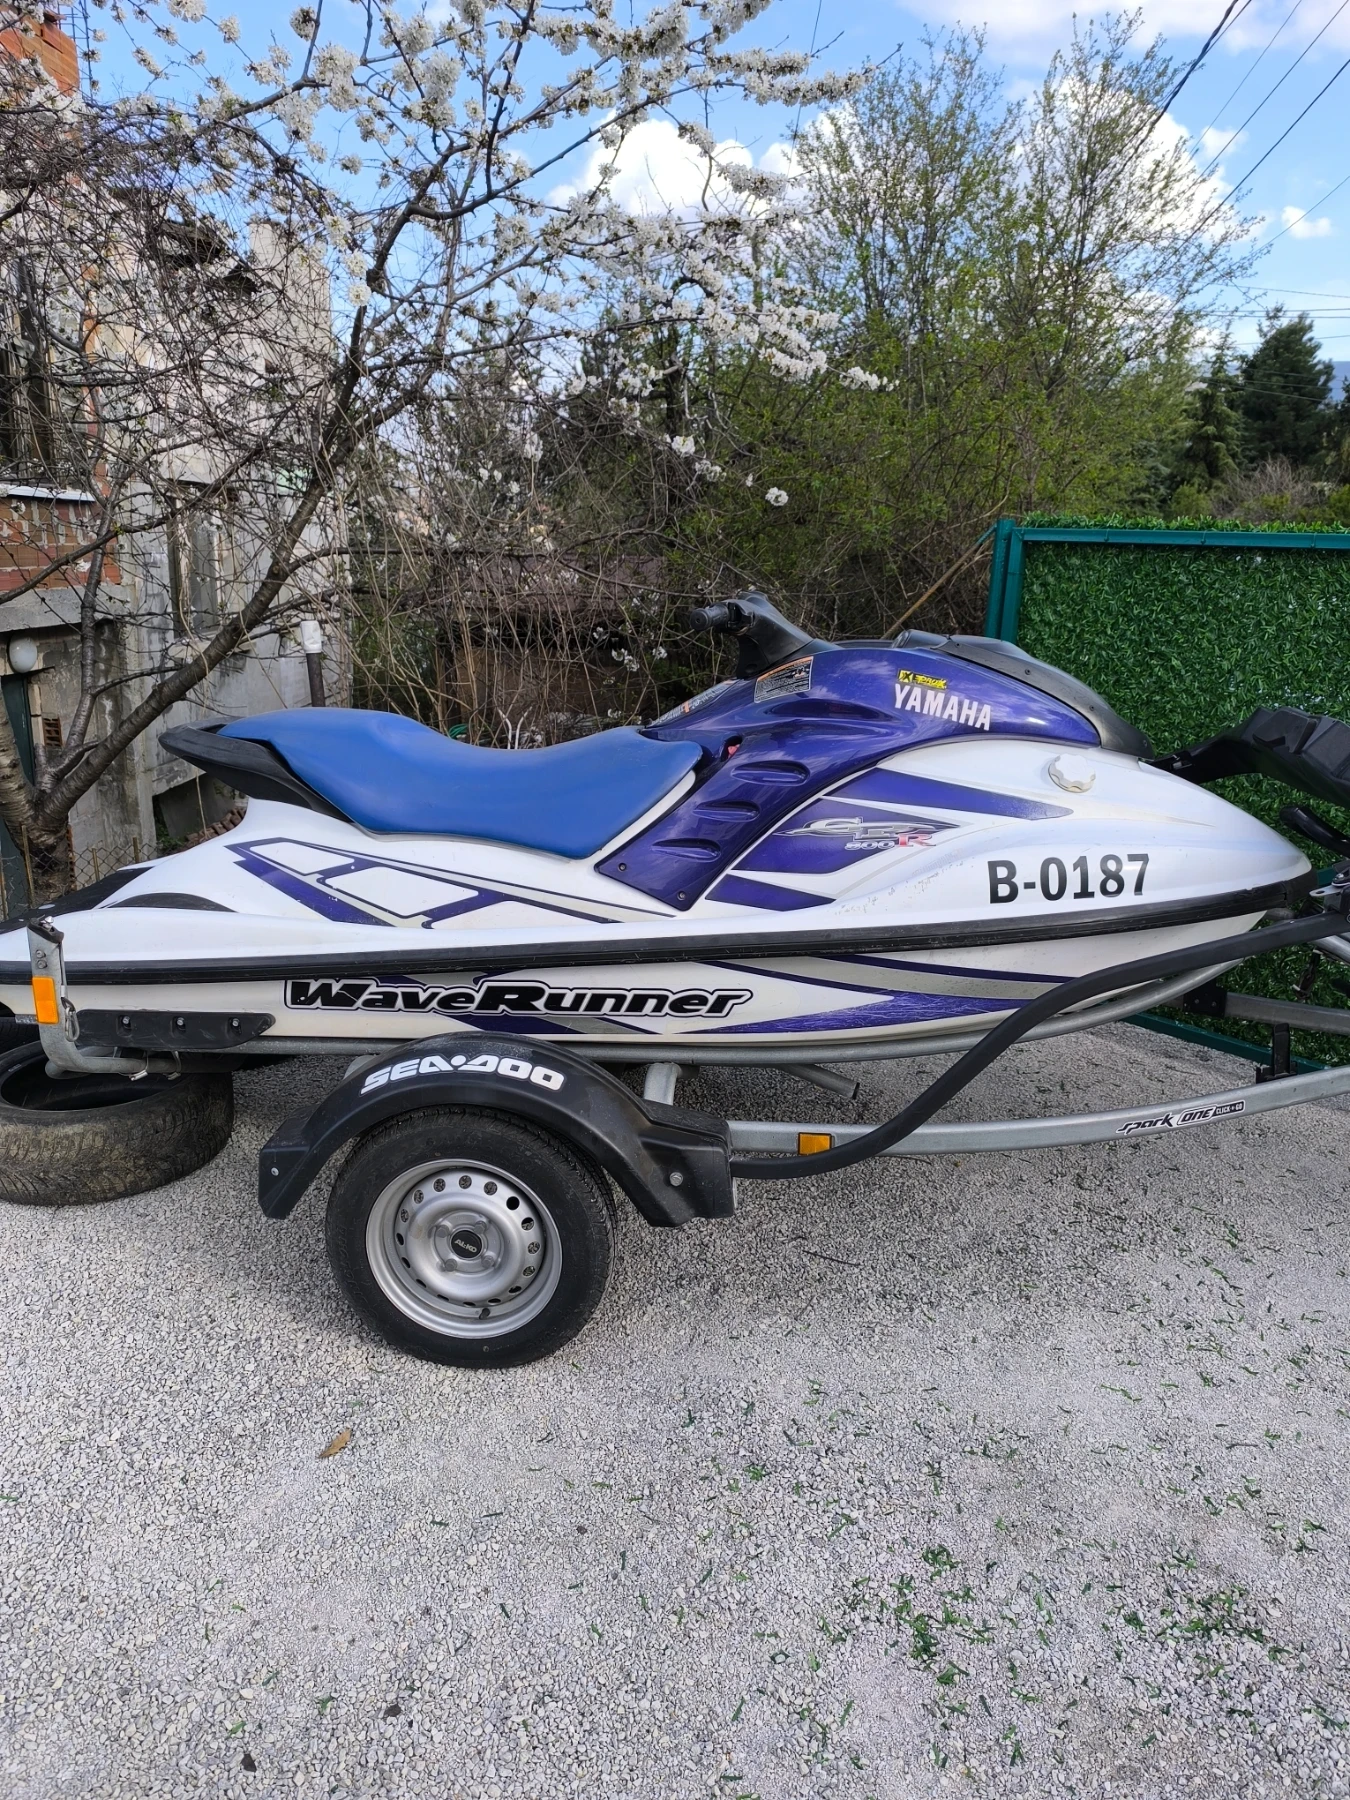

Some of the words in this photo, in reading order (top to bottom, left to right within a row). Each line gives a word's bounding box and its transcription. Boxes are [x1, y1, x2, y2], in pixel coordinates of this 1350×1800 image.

[895, 684, 991, 731] YAMAHA
[987, 853, 1150, 904] B-0187
[286, 979, 753, 1018] WaveRunner
[1117, 1113, 1174, 1135] spark
